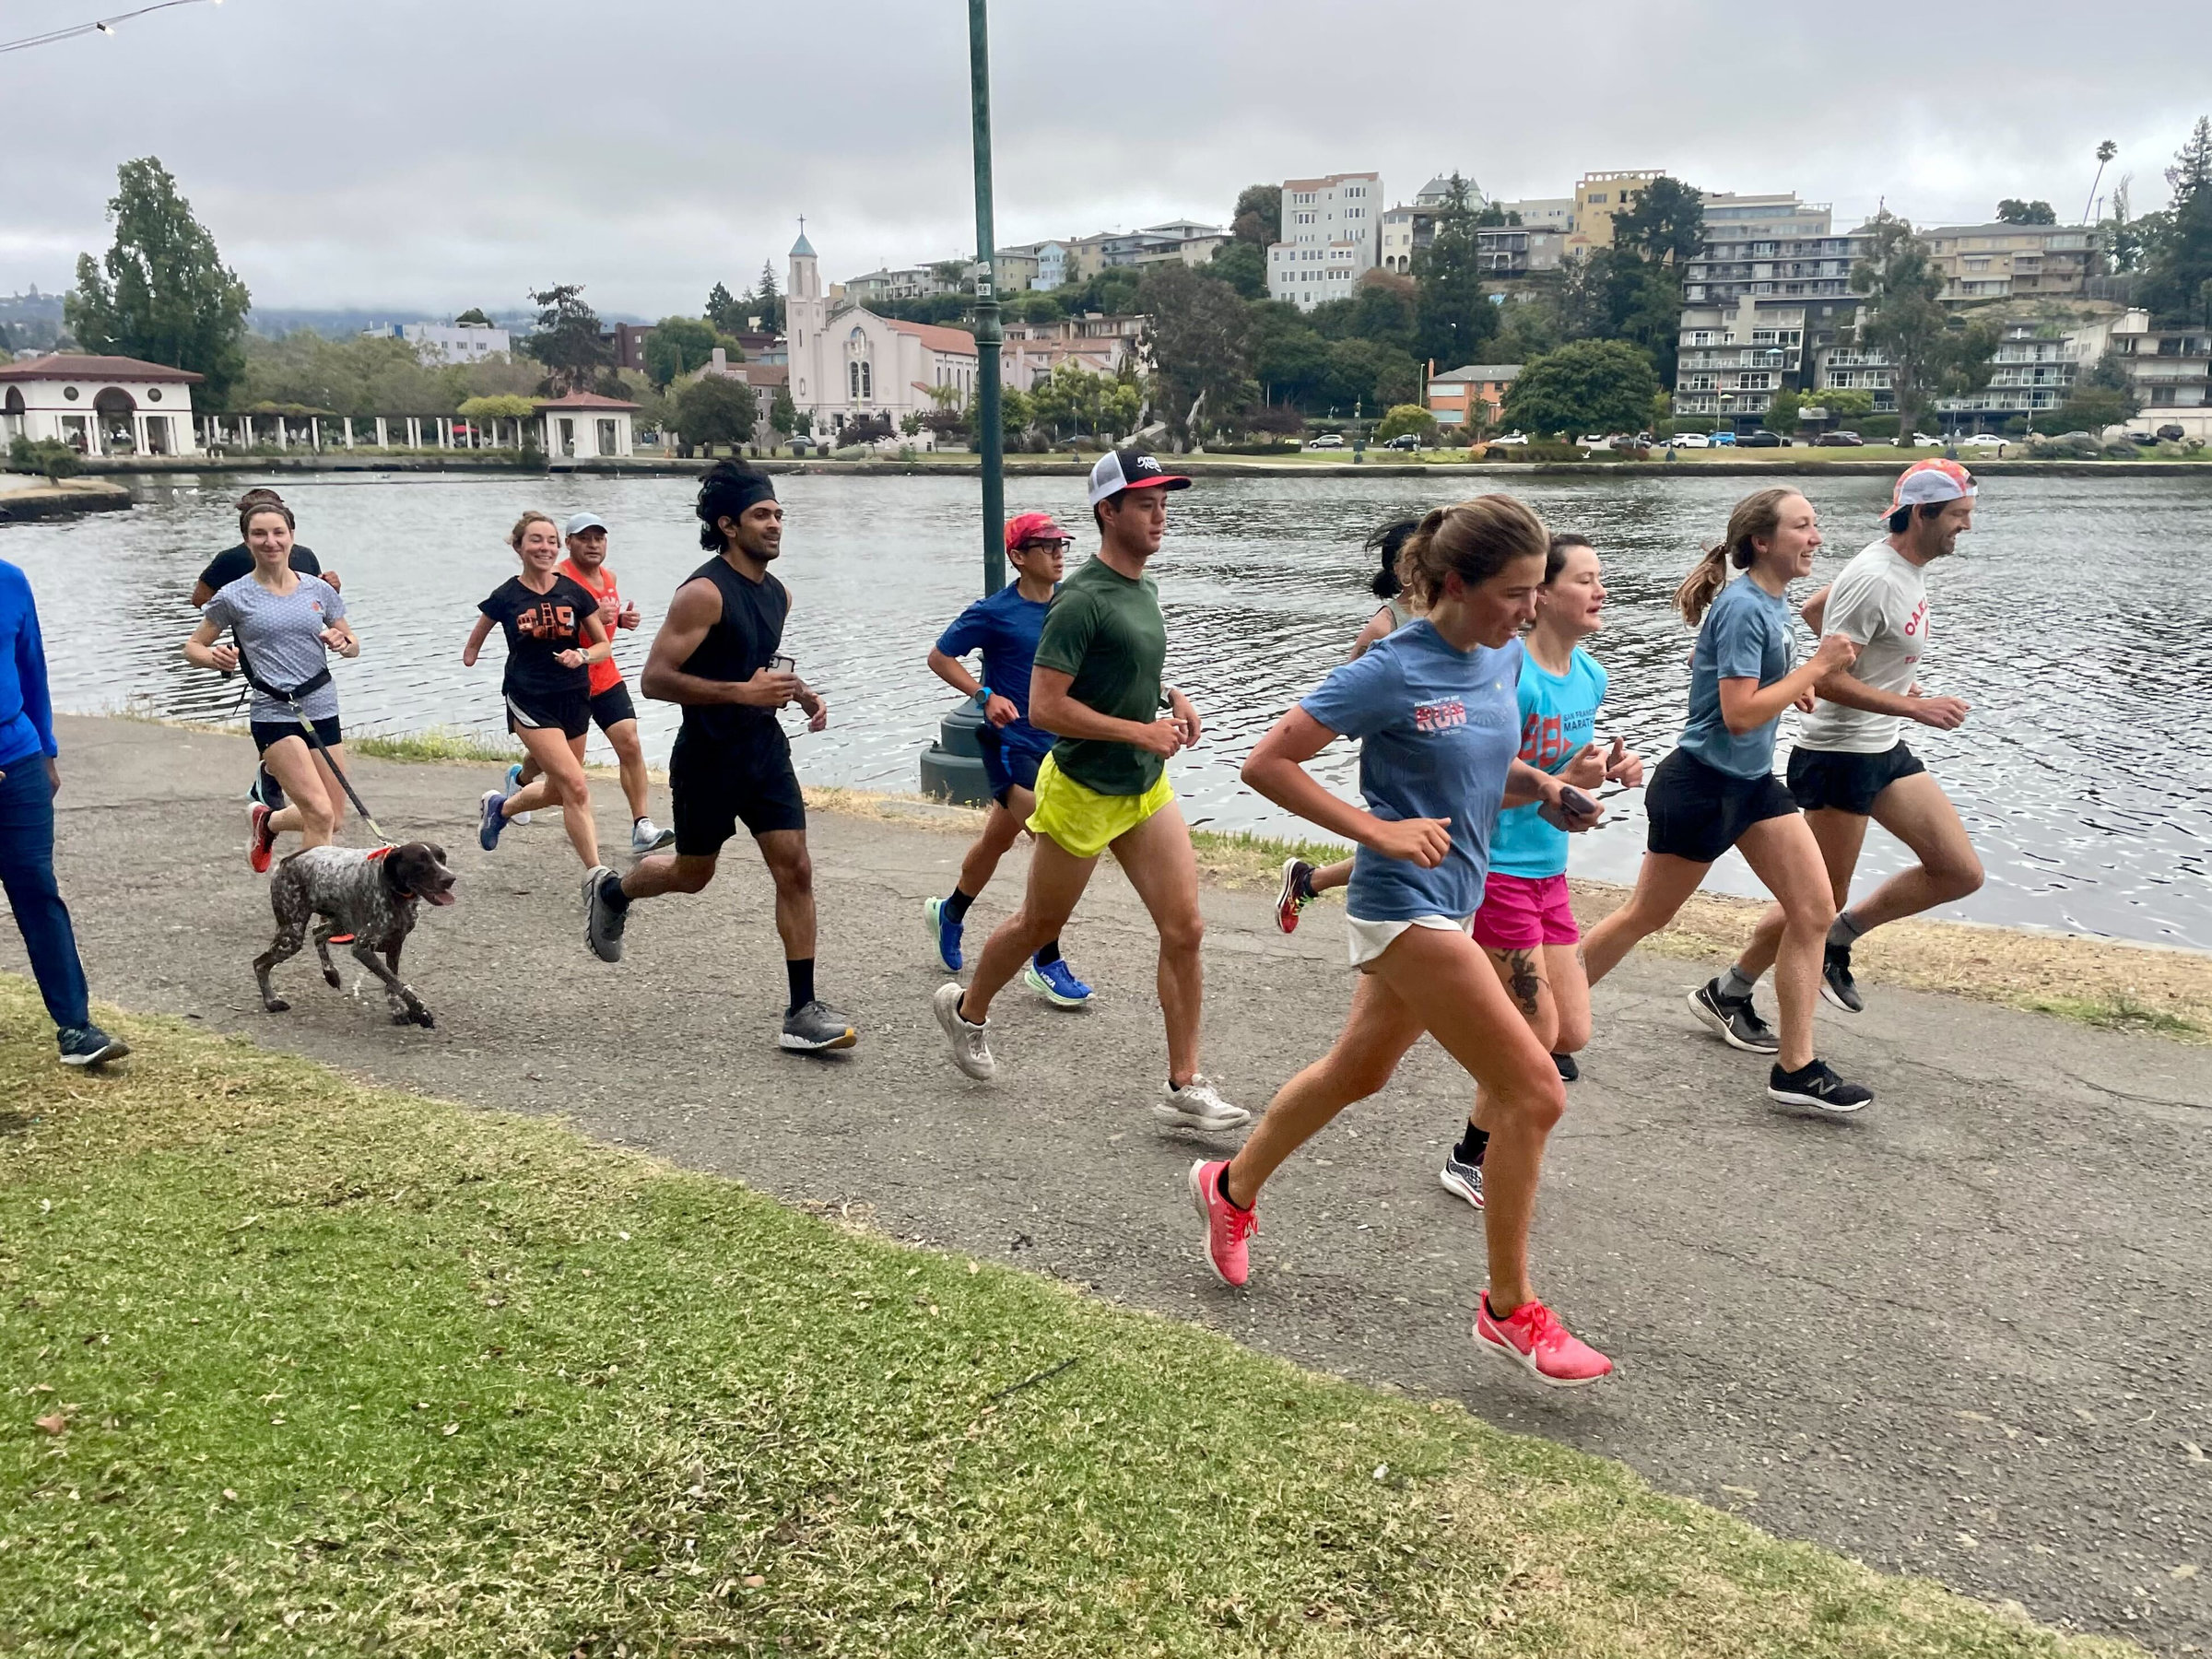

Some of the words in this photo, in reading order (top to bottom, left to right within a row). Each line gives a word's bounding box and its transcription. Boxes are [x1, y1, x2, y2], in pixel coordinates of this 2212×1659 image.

[1416, 700, 1467, 732] RUN
[1564, 712, 1575, 721] SAN
[1041, 971, 1056, 989] HOKA
